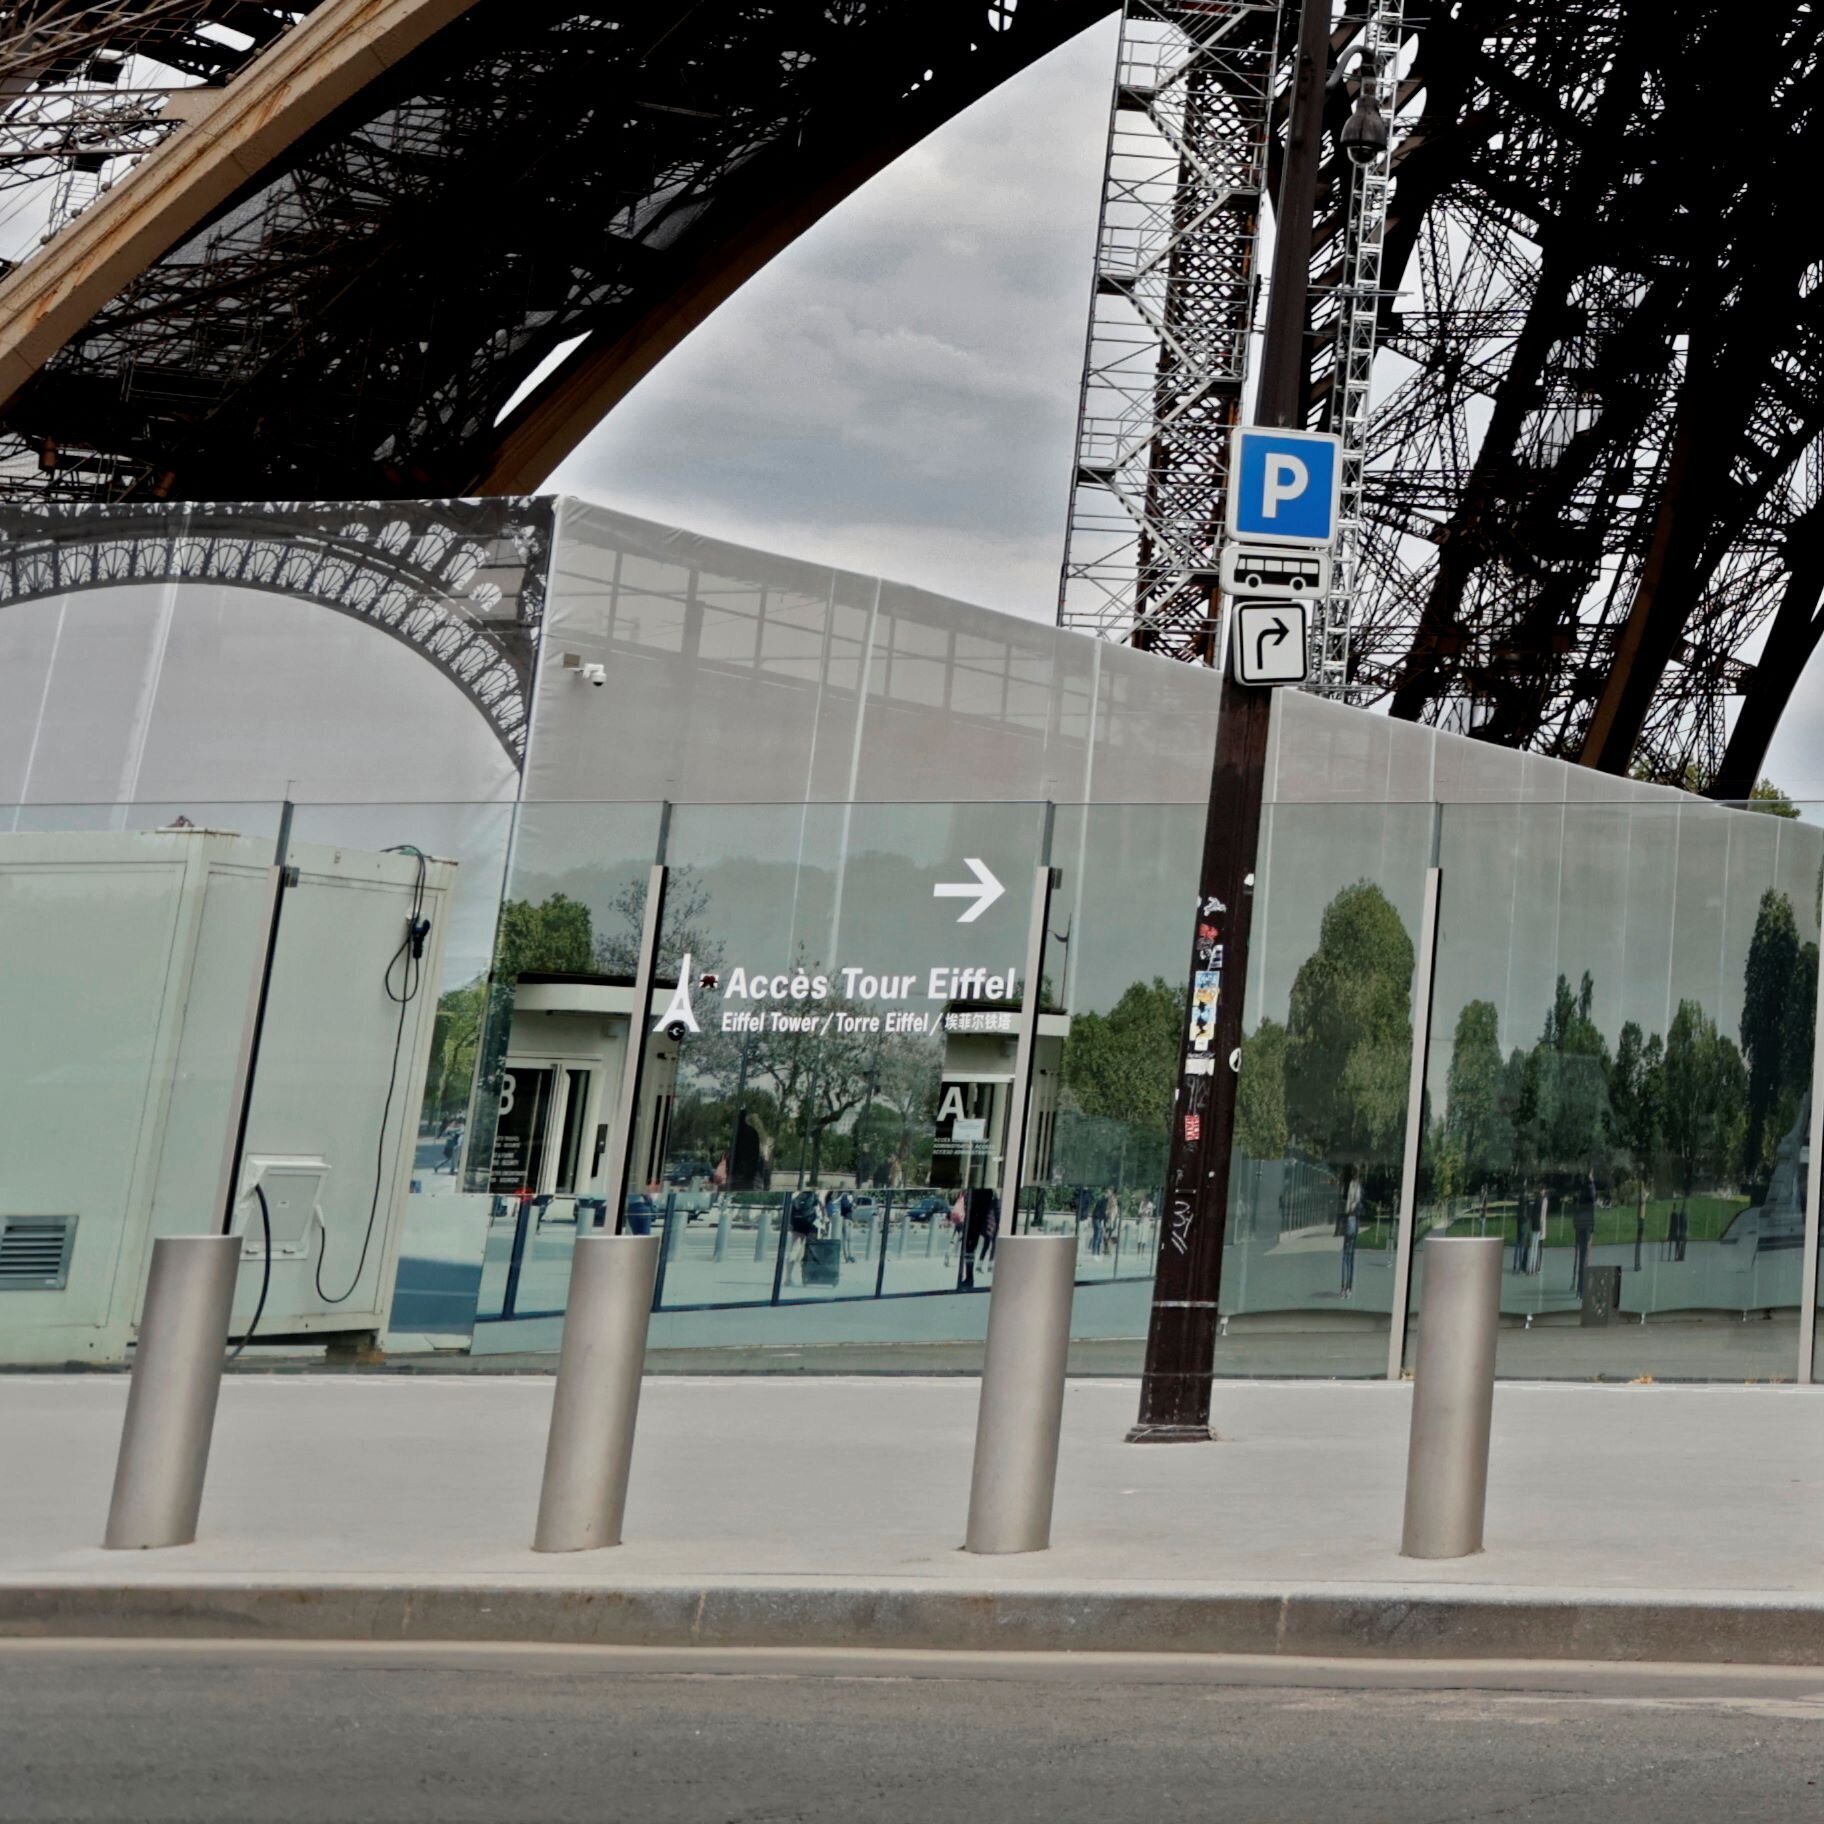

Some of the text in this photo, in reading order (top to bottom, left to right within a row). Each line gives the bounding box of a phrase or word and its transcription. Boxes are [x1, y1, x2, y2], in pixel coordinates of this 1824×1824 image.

[1262, 453, 1309, 518] P
[724, 967, 1015, 999] Accès Tour Eiffel
[722, 1012, 765, 1032] Eiffel
[769, 1013, 818, 1032] Tower
[836, 1013, 880, 1032] Torre
[885, 1012, 928, 1032] Eiffel
[499, 1074, 516, 1115] B
[937, 1086, 965, 1121] A
